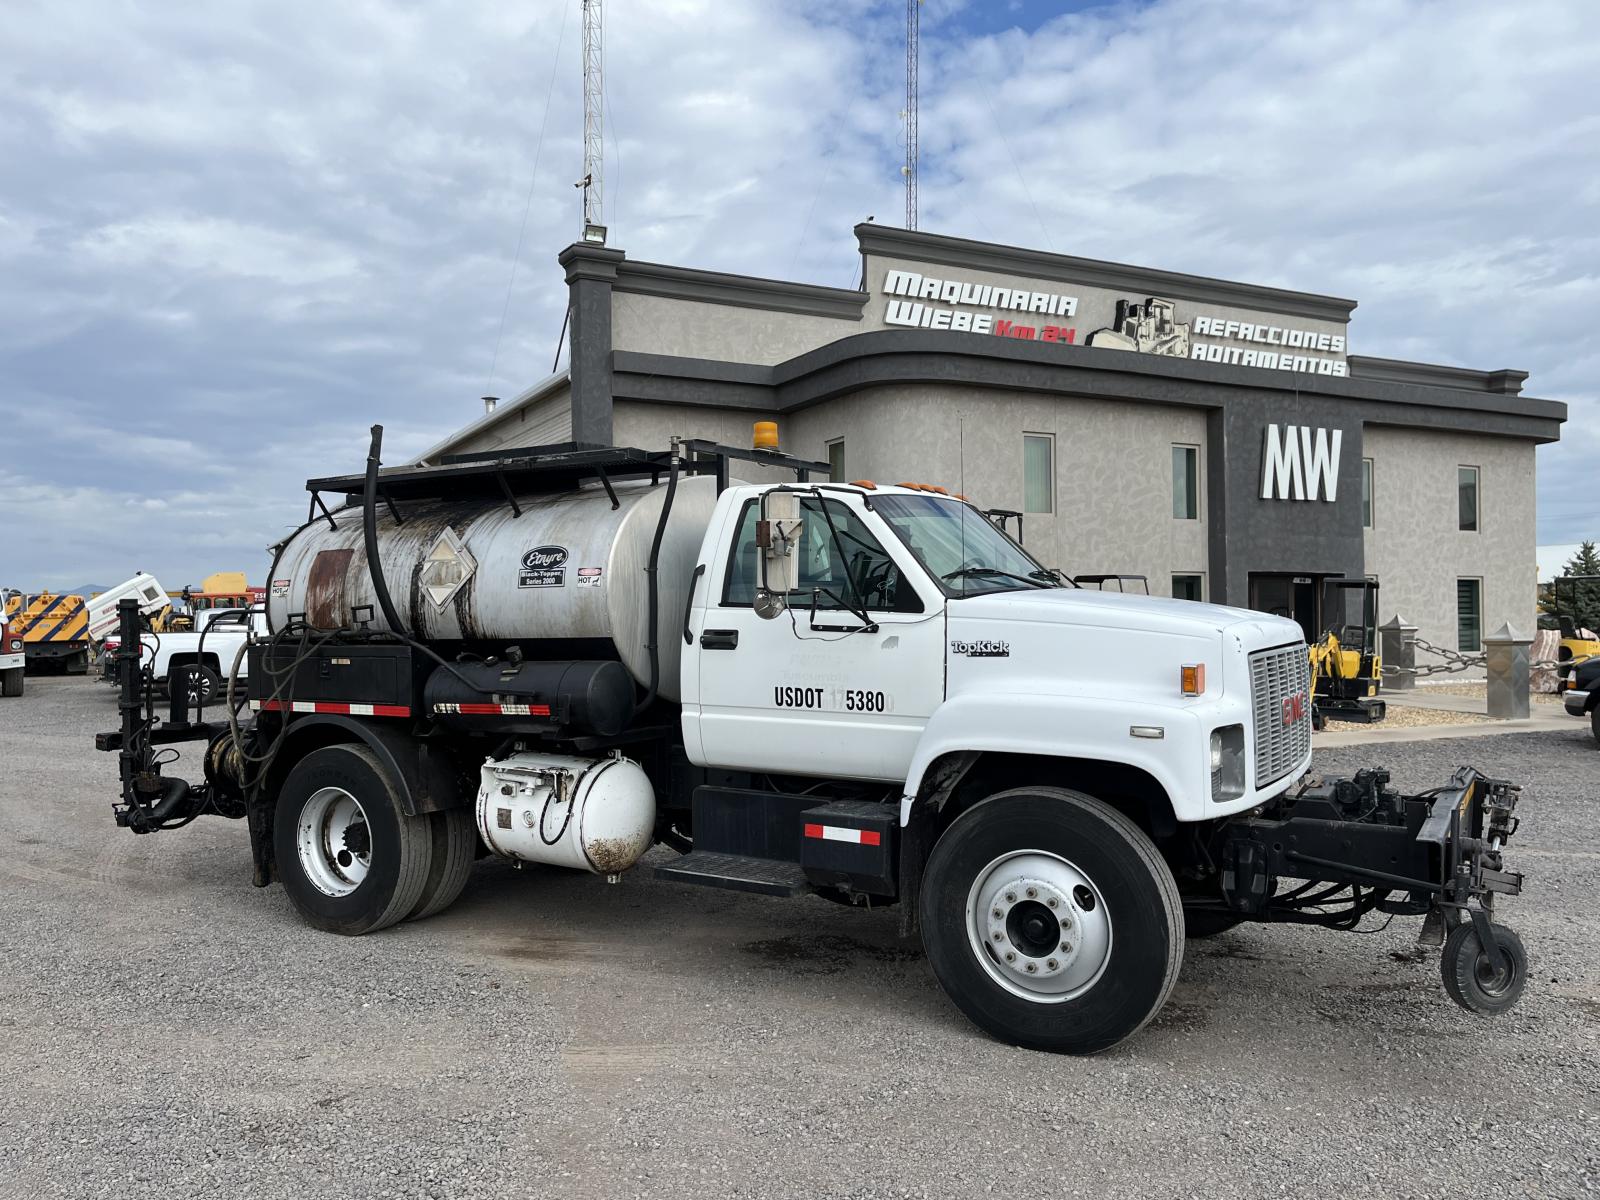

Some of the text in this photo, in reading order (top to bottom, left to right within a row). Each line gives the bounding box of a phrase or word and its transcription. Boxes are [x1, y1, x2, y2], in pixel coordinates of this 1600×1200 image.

[883, 270, 1079, 317] MAQUINARIA
[884, 300, 993, 335] WIEBE
[1042, 326, 1076, 344] 24
[1193, 316, 1346, 352] REFACCIONES
[1190, 343, 1347, 377] ADITAMENTOS
[1260, 423, 1343, 502] MW
[526, 551, 563, 567] Etnyre
[578, 576, 591, 584] HOT
[951, 641, 1009, 657] TopKick
[774, 686, 824, 709] USDOT
